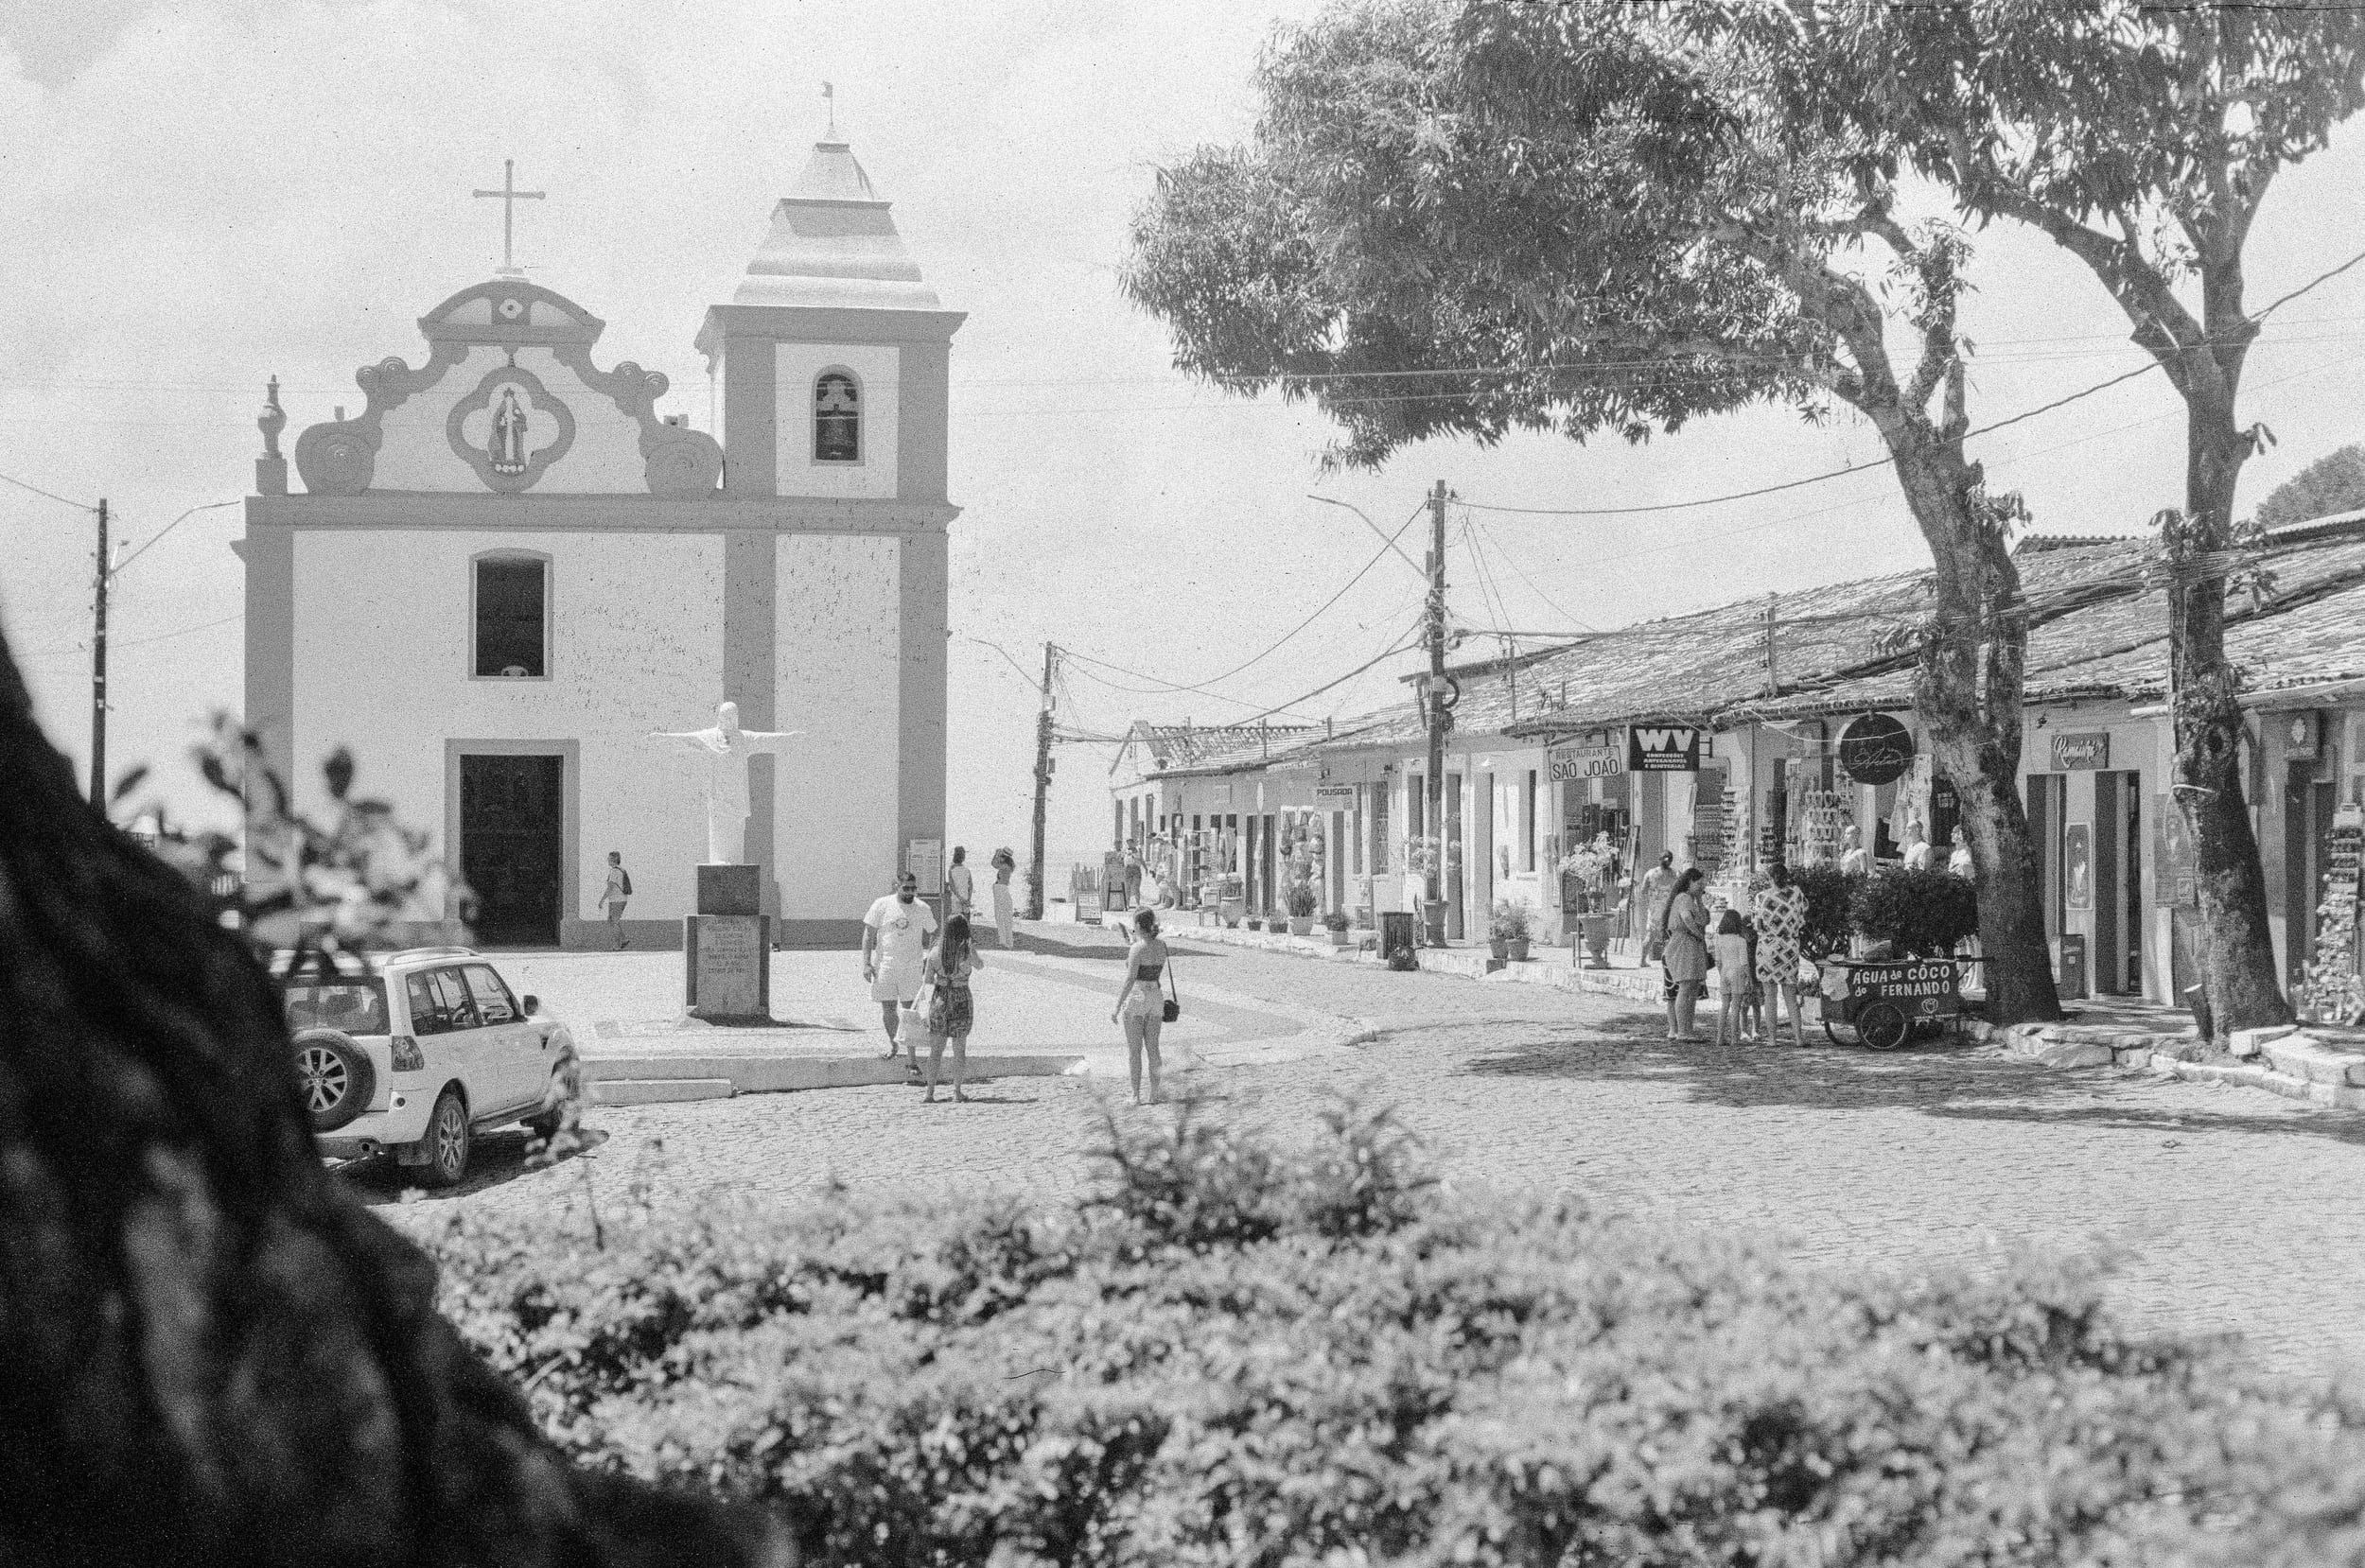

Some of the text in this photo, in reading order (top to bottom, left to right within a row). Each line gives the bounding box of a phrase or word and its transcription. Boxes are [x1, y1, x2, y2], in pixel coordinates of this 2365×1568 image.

[1636, 729, 1694, 752] WV
[1555, 747, 1614, 759] RESTAURANTE
[1852, 964, 1950, 985] ÁGUA de CÔCO
[1854, 980, 1950, 998] do FERNANDO
